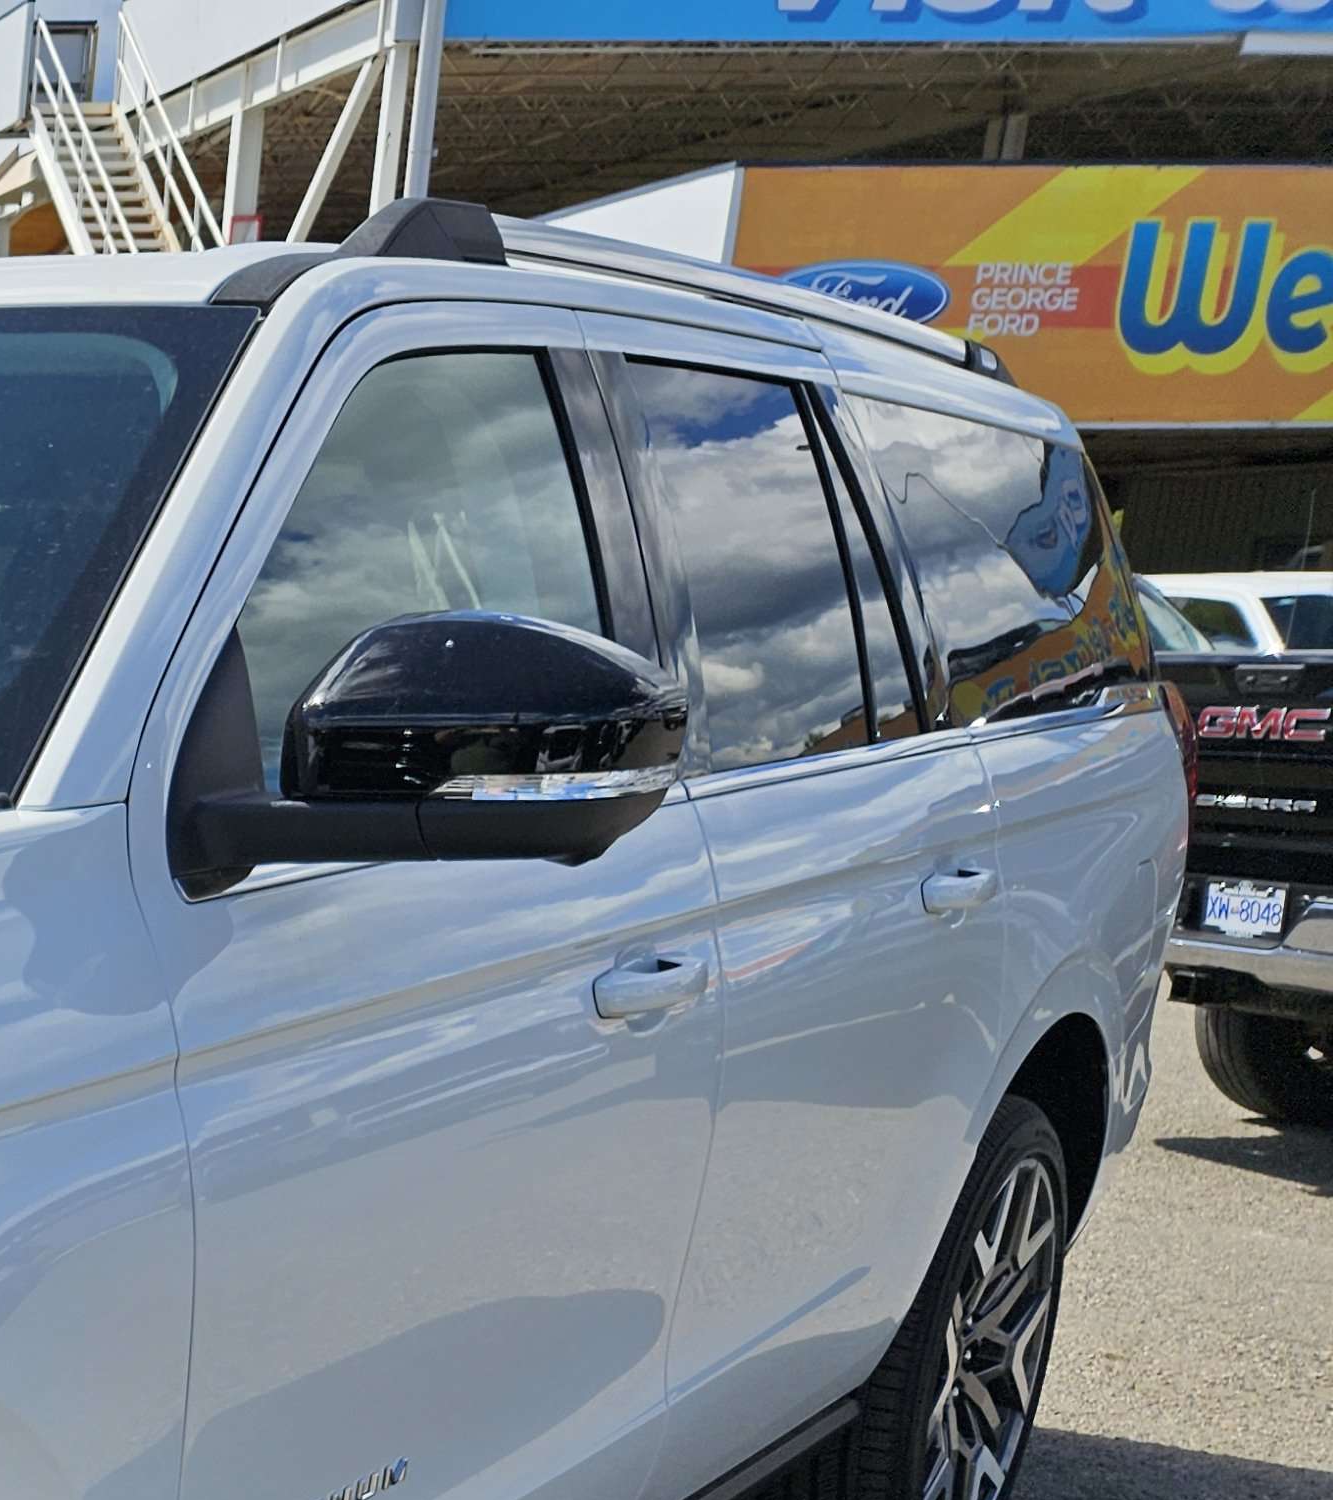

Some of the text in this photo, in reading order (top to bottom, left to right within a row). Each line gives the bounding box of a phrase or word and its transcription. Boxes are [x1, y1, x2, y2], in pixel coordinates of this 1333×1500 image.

[975, 262, 1074, 286] PRINCE
[970, 287, 1080, 312] GEORGE
[966, 313, 1041, 338] FORD
[1198, 704, 1332, 742] GMC
